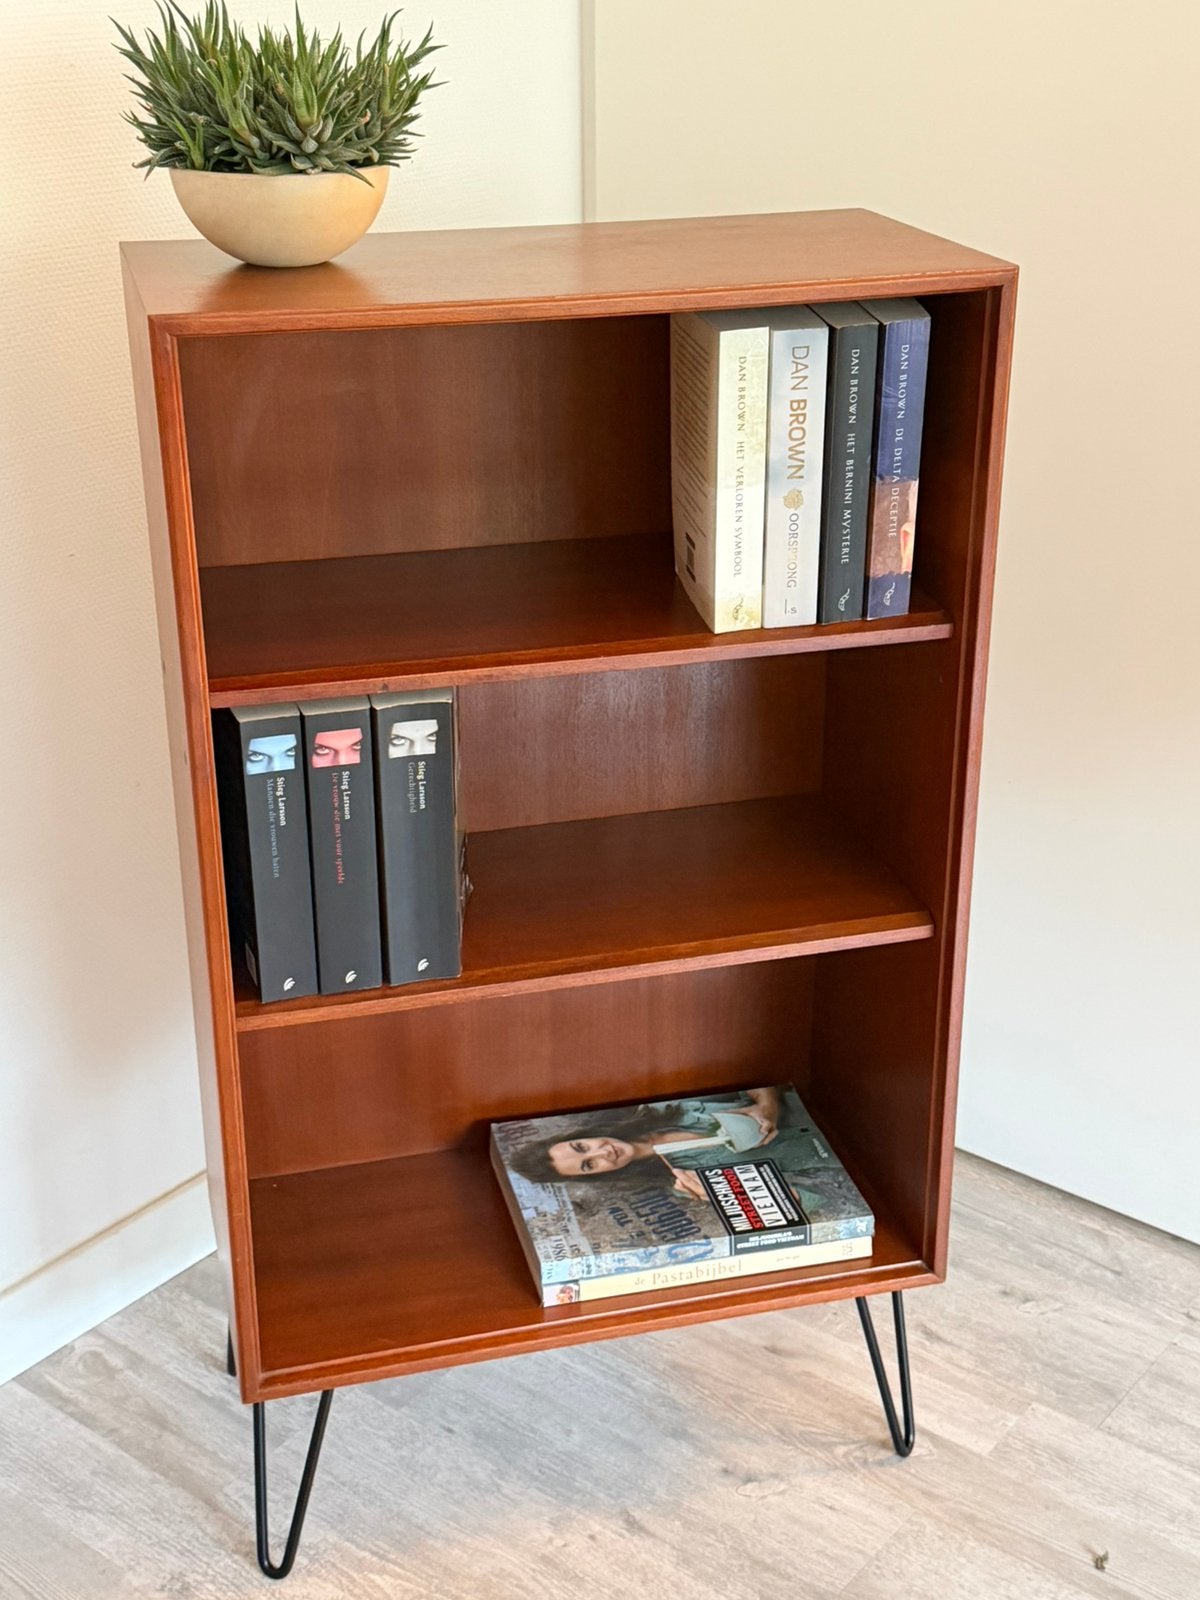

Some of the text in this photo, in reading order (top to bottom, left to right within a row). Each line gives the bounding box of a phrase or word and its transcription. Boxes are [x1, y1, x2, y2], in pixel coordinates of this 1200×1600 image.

[733, 356, 747, 578] DAN BROWN HET VERLOREN SYMBOOL
[786, 346, 810, 588] DAN BROWN OORSPRONG
[840, 348, 860, 565] DAN BROWN HET BERNINI MYSTERIE
[888, 344, 910, 538] DAN BROWN DE DELTA DECEPTIE
[266, 778, 275, 810] Mannen
[276, 777, 287, 826] Stieg Larsson
[341, 771, 351, 820] Stieg Larsson
[407, 762, 417, 813] Gerechtigheid
[416, 761, 427, 809] Stieg Larsson
[705, 1169, 752, 1232] MILJUSCHKA'S
[724, 1168, 764, 1229] STREET FOOD
[738, 1166, 782, 1225] VIETNAM
[635, 1260, 742, 1286] de Pastabijbel
